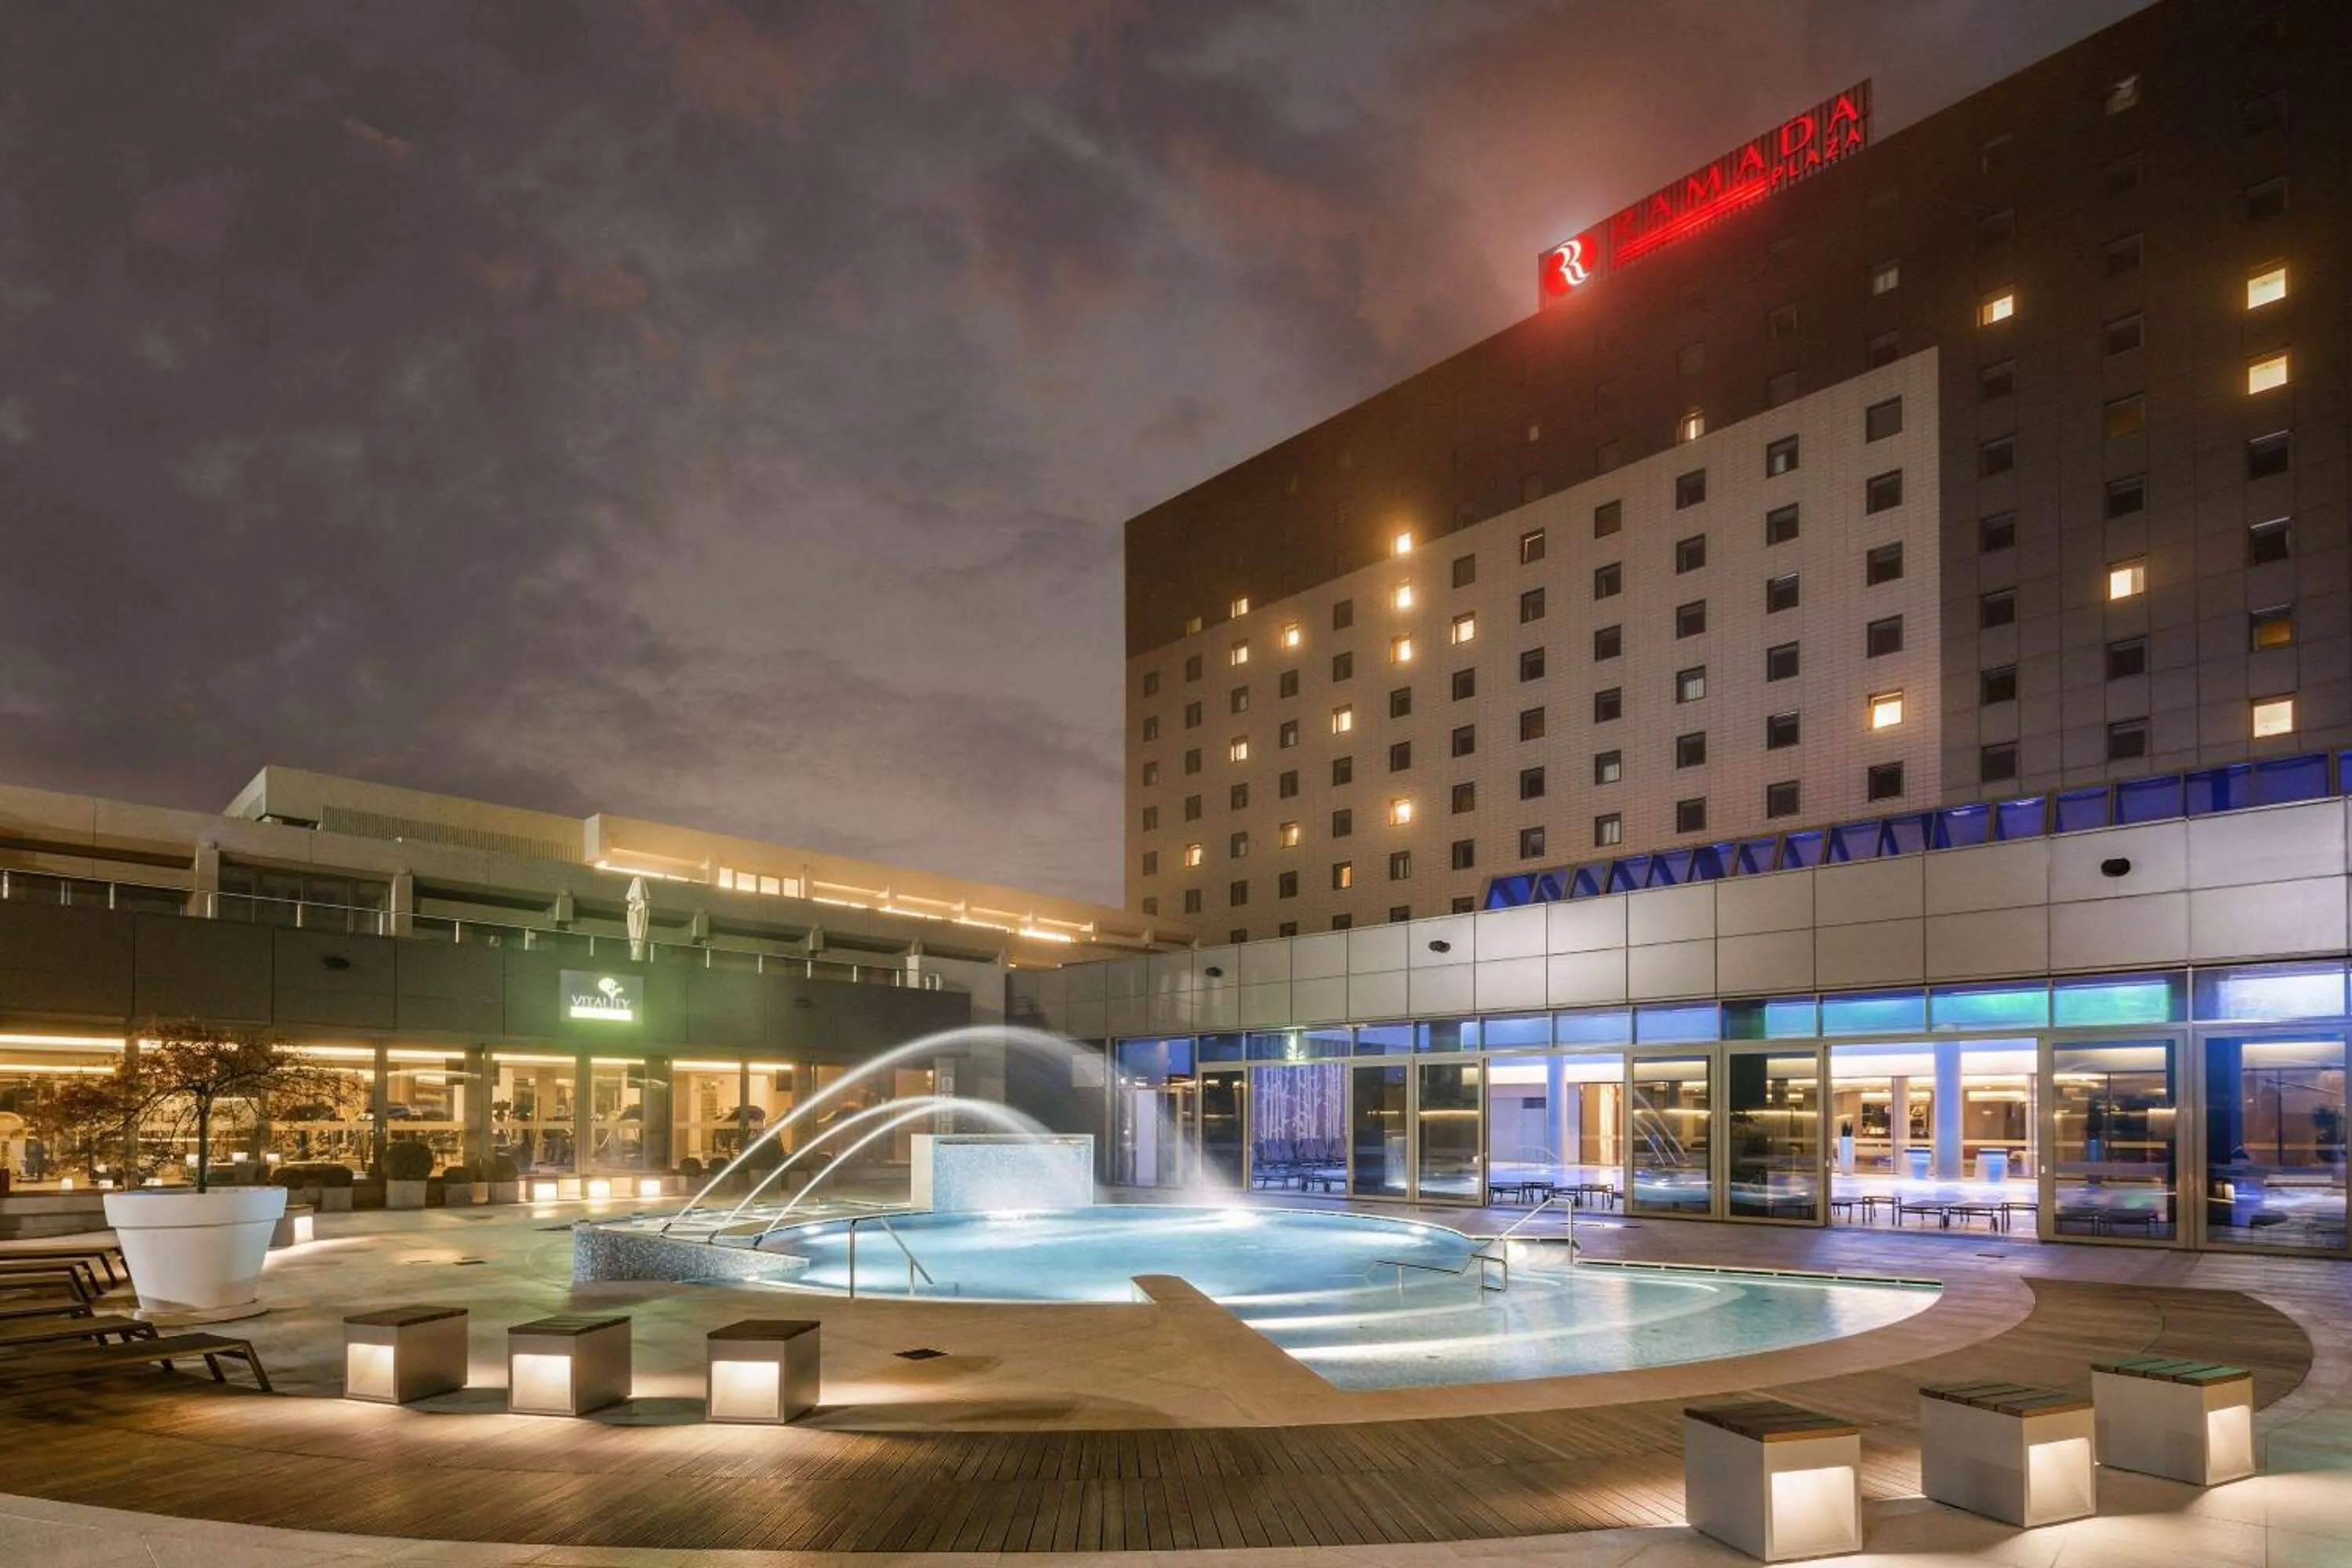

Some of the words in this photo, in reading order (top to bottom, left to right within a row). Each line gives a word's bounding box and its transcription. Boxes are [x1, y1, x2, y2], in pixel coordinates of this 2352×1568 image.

[1612, 95, 1857, 240] RAMADA
[1770, 128, 1862, 186] PLAZA
[571, 993, 630, 1010] VITALITY
